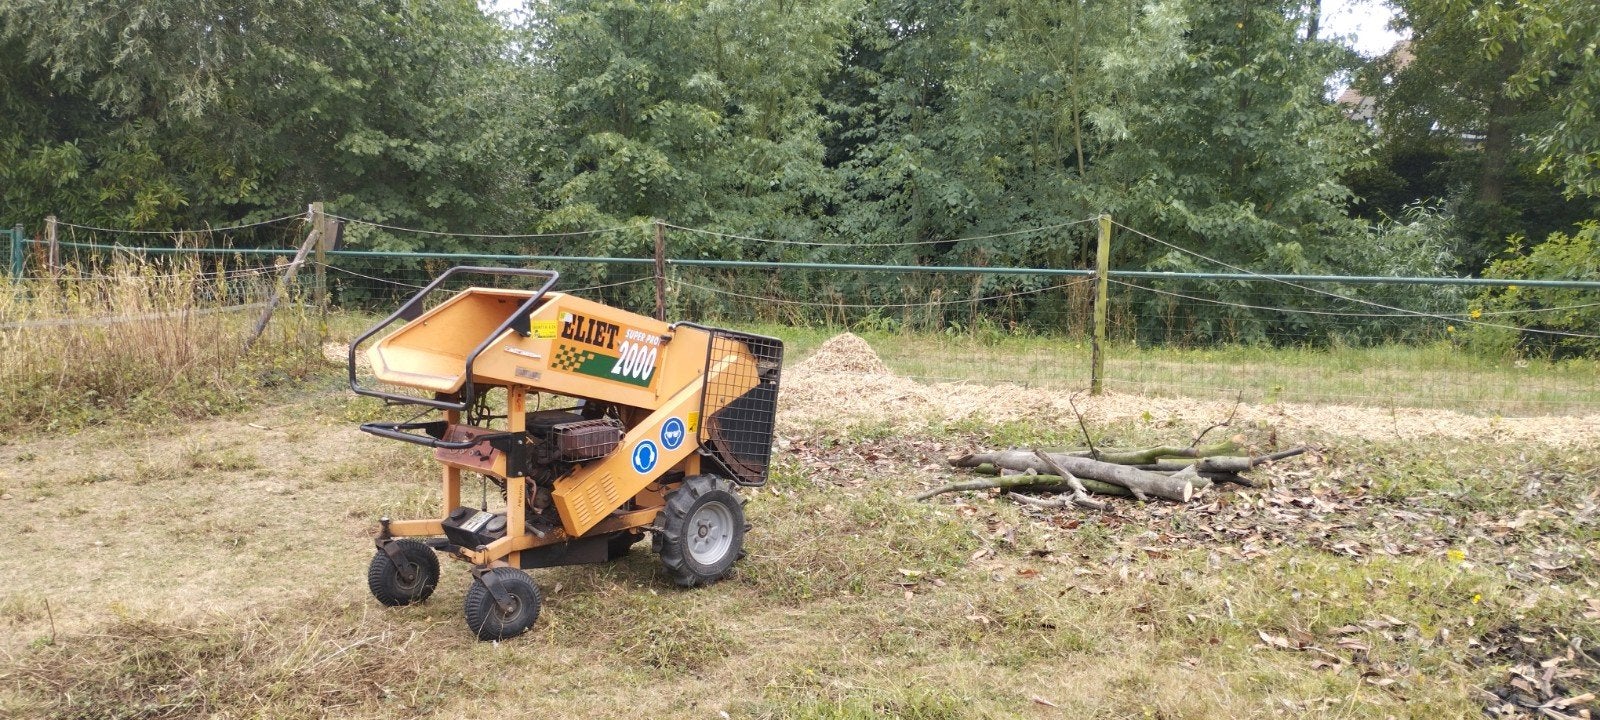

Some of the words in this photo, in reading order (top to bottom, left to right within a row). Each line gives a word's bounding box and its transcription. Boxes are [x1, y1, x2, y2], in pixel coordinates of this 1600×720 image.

[561, 314, 620, 349] ELIET
[625, 329, 646, 342] SUPER
[611, 340, 658, 381] 2000
